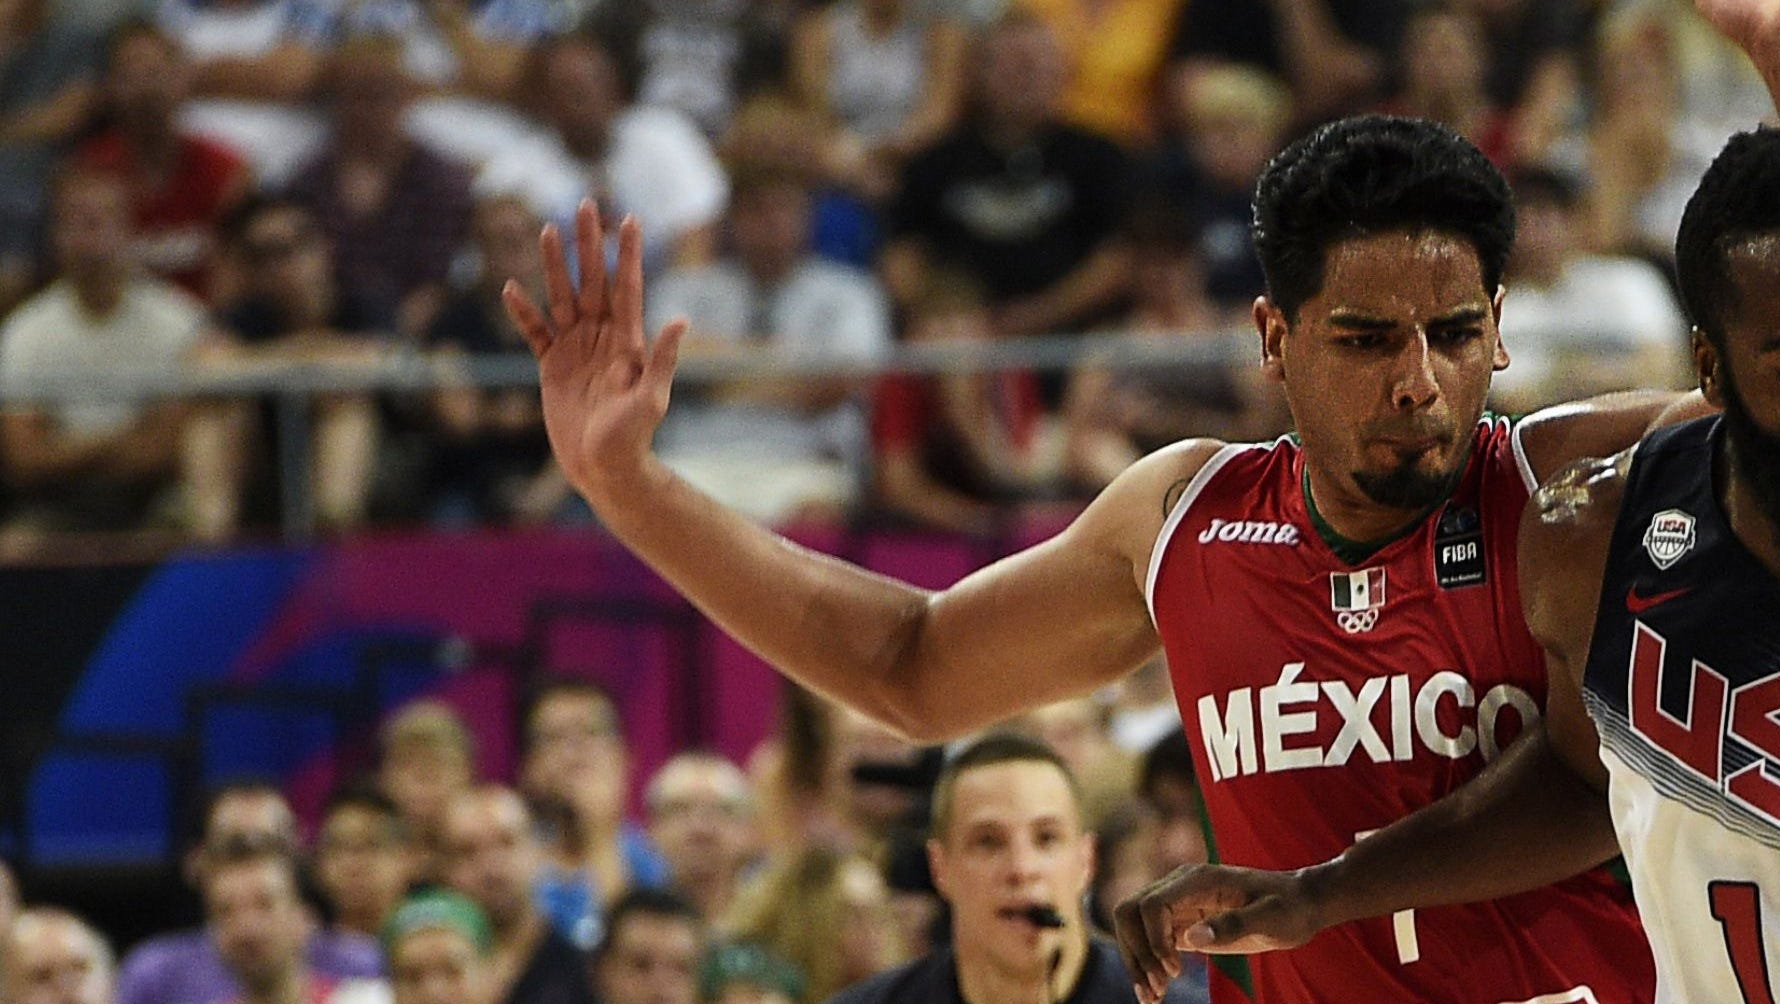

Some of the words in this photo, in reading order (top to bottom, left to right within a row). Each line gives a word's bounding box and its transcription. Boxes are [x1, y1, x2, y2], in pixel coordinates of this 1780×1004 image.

[1198, 518, 1299, 546] Joma
[1442, 541, 1477, 565] FIBA
[1198, 662, 1540, 783] MÉXICO
